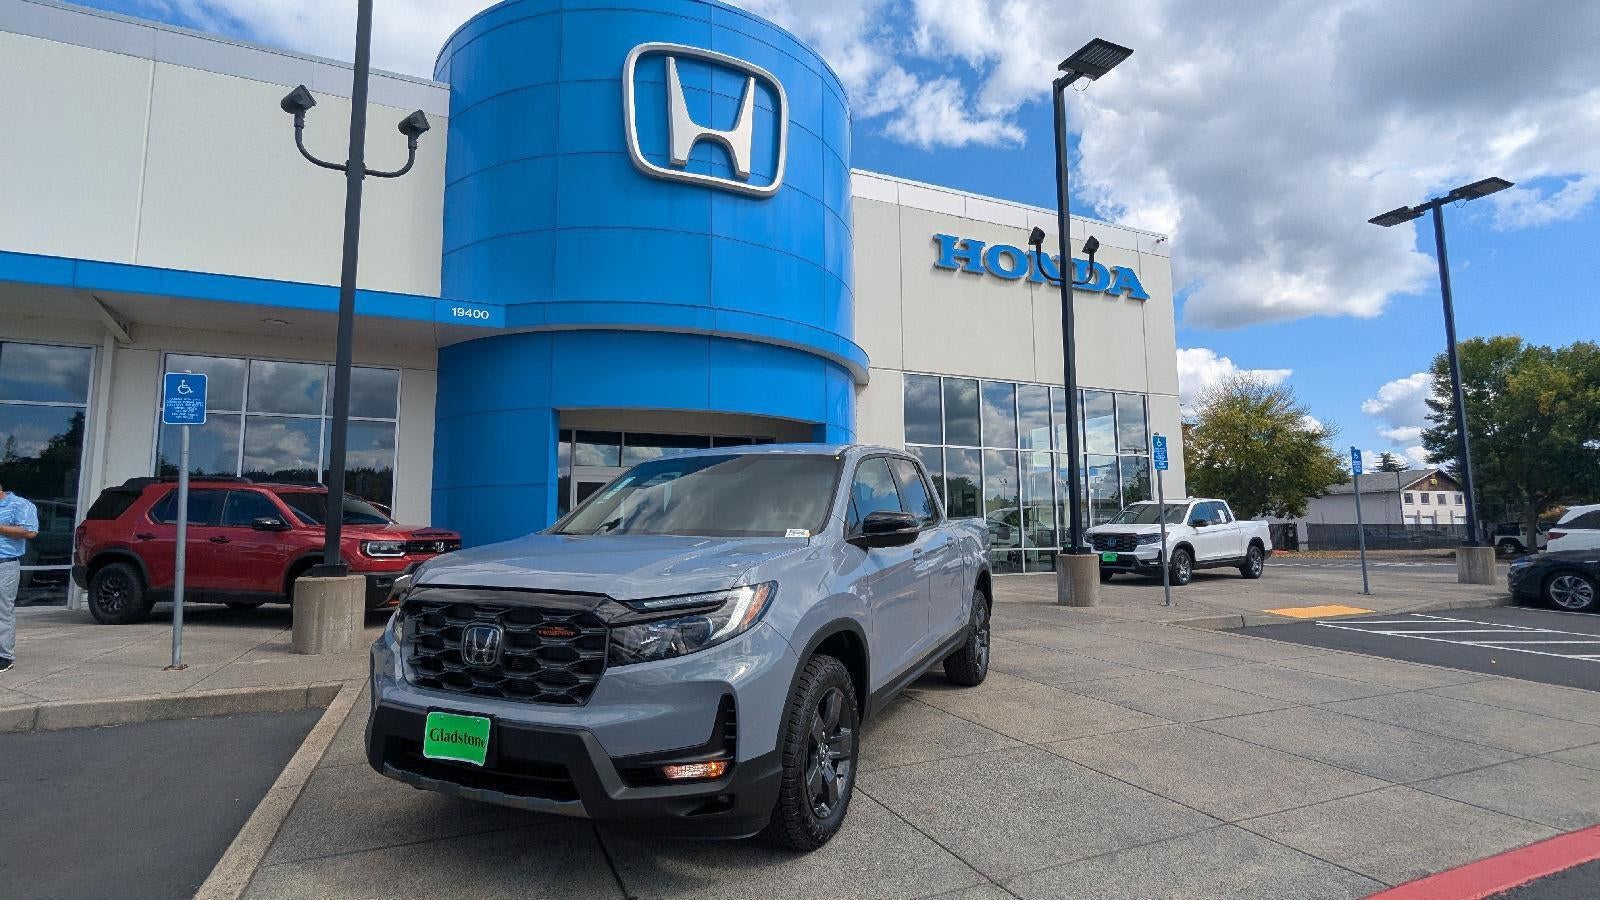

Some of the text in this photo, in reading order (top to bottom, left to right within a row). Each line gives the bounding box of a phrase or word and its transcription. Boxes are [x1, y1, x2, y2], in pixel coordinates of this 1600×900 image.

[932, 233, 1151, 300] HONDA
[451, 307, 489, 320] 19400
[429, 727, 486, 749] Gladstone
